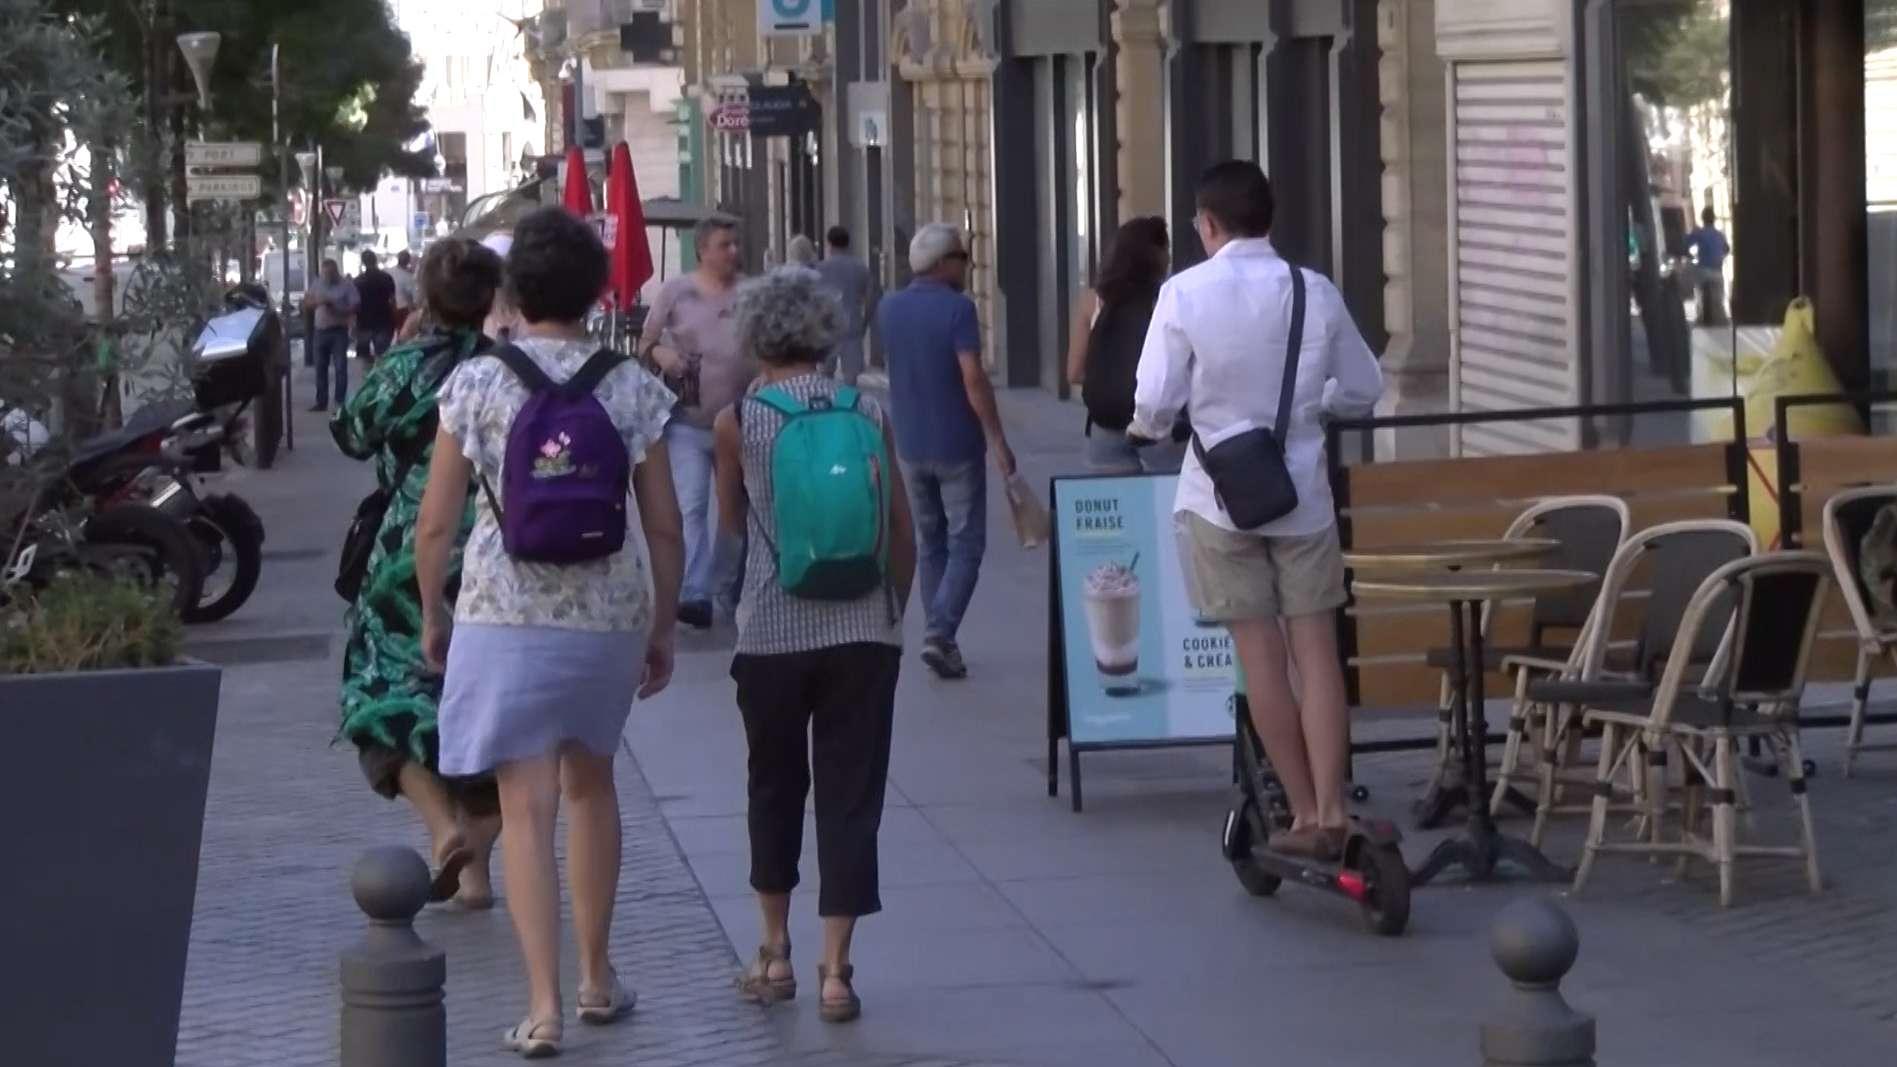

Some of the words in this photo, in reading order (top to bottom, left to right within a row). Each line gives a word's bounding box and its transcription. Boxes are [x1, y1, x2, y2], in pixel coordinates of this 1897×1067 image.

[1074, 499, 1120, 514] DONUT
[1076, 515, 1124, 531] FRAISE
[1184, 655, 1193, 668] &
